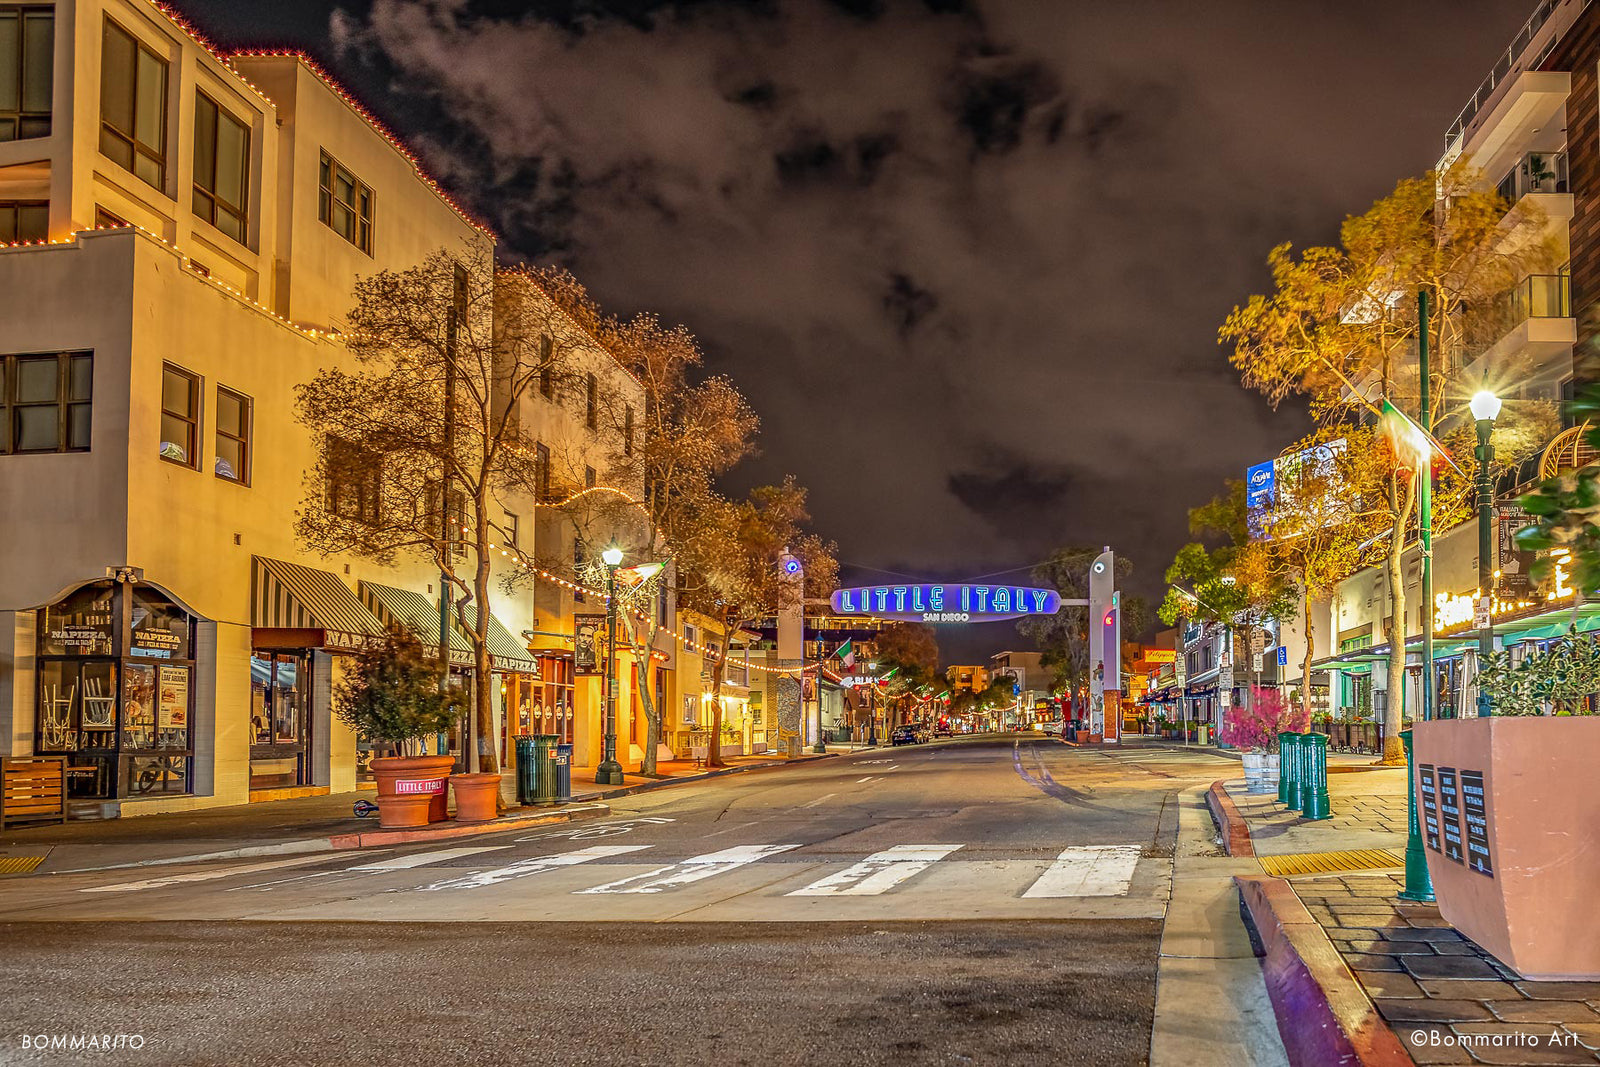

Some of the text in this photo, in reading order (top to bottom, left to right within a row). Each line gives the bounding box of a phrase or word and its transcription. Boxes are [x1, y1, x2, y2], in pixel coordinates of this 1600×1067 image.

[842, 586, 1049, 612] LITTLE ITALY
[922, 613, 970, 622] SAN DIEGO
[51, 631, 107, 639] NAPIZZA
[135, 631, 181, 643] NAPIZZA
[326, 630, 386, 650] NAPIZZ
[421, 645, 476, 664] NAIZZA
[494, 656, 537, 672] NAPIZZA
[398, 781, 442, 792] LITTLE ITALY
